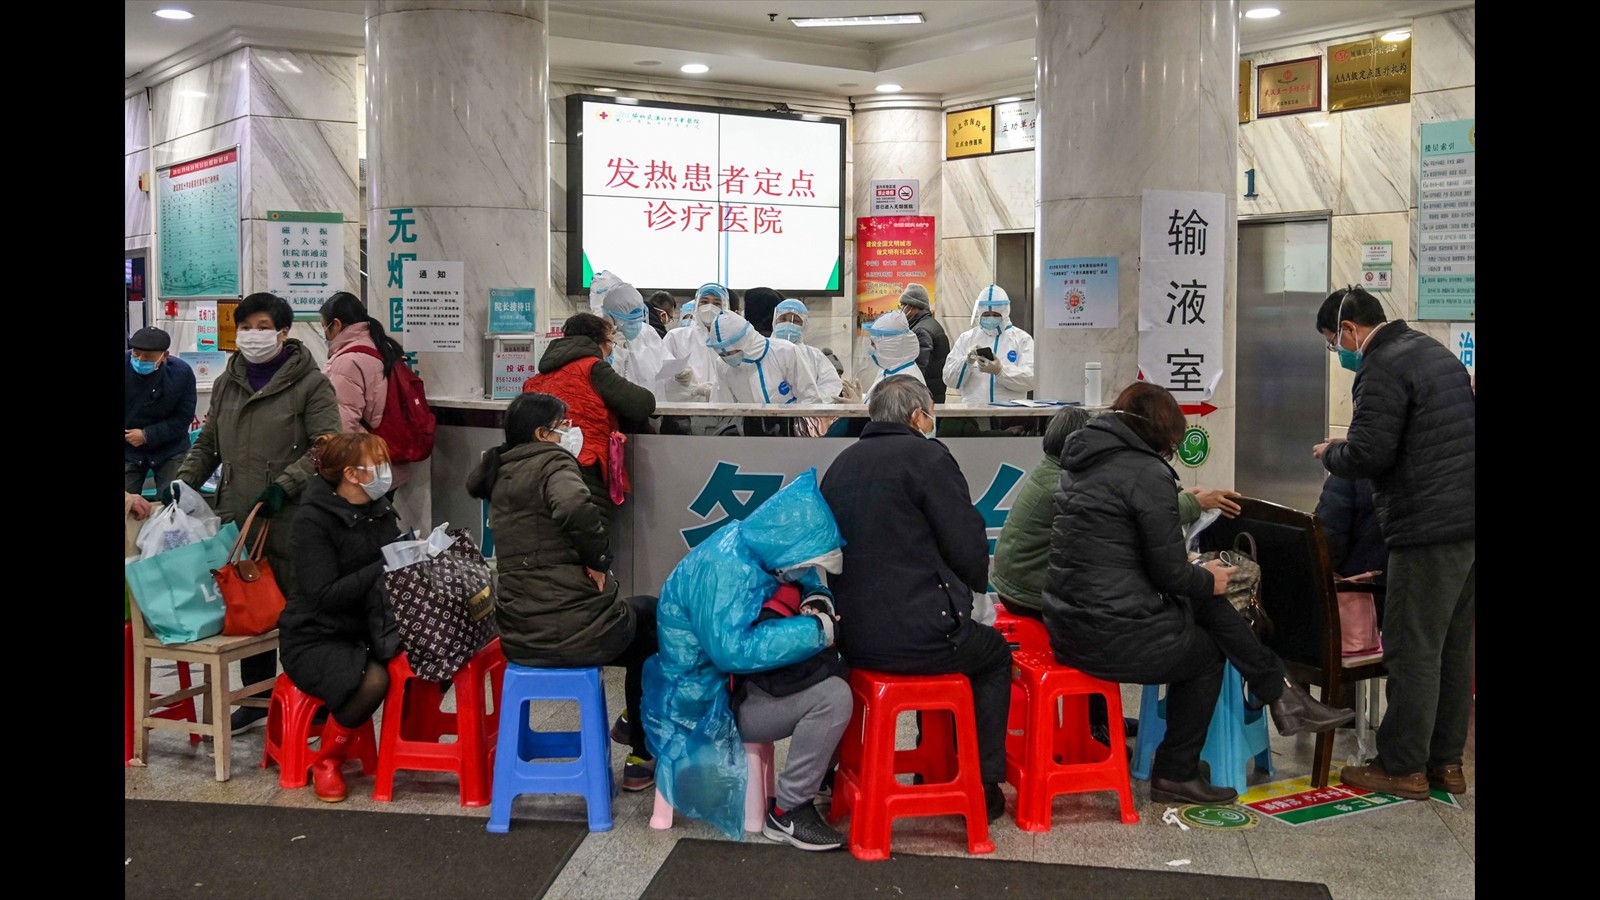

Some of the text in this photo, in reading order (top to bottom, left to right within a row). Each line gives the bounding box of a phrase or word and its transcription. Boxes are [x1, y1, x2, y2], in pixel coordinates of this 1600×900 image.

[1425, 142, 1455, 152] 楼层索引
[605, 157, 816, 198] 发热患者定点
[1244, 168, 1259, 197] 1
[643, 200, 783, 234] 诊疗医院
[281, 226, 328, 235] 磁共振
[282, 238, 328, 246] 介入室
[282, 249, 328, 258] 住院部通道
[282, 260, 328, 269] 感染科门诊
[282, 271, 328, 280] 发热门诊
[419, 270, 446, 279] 通知
[1166, 209, 1209, 392] 输液室
[494, 302, 531, 312] 院长接待日
